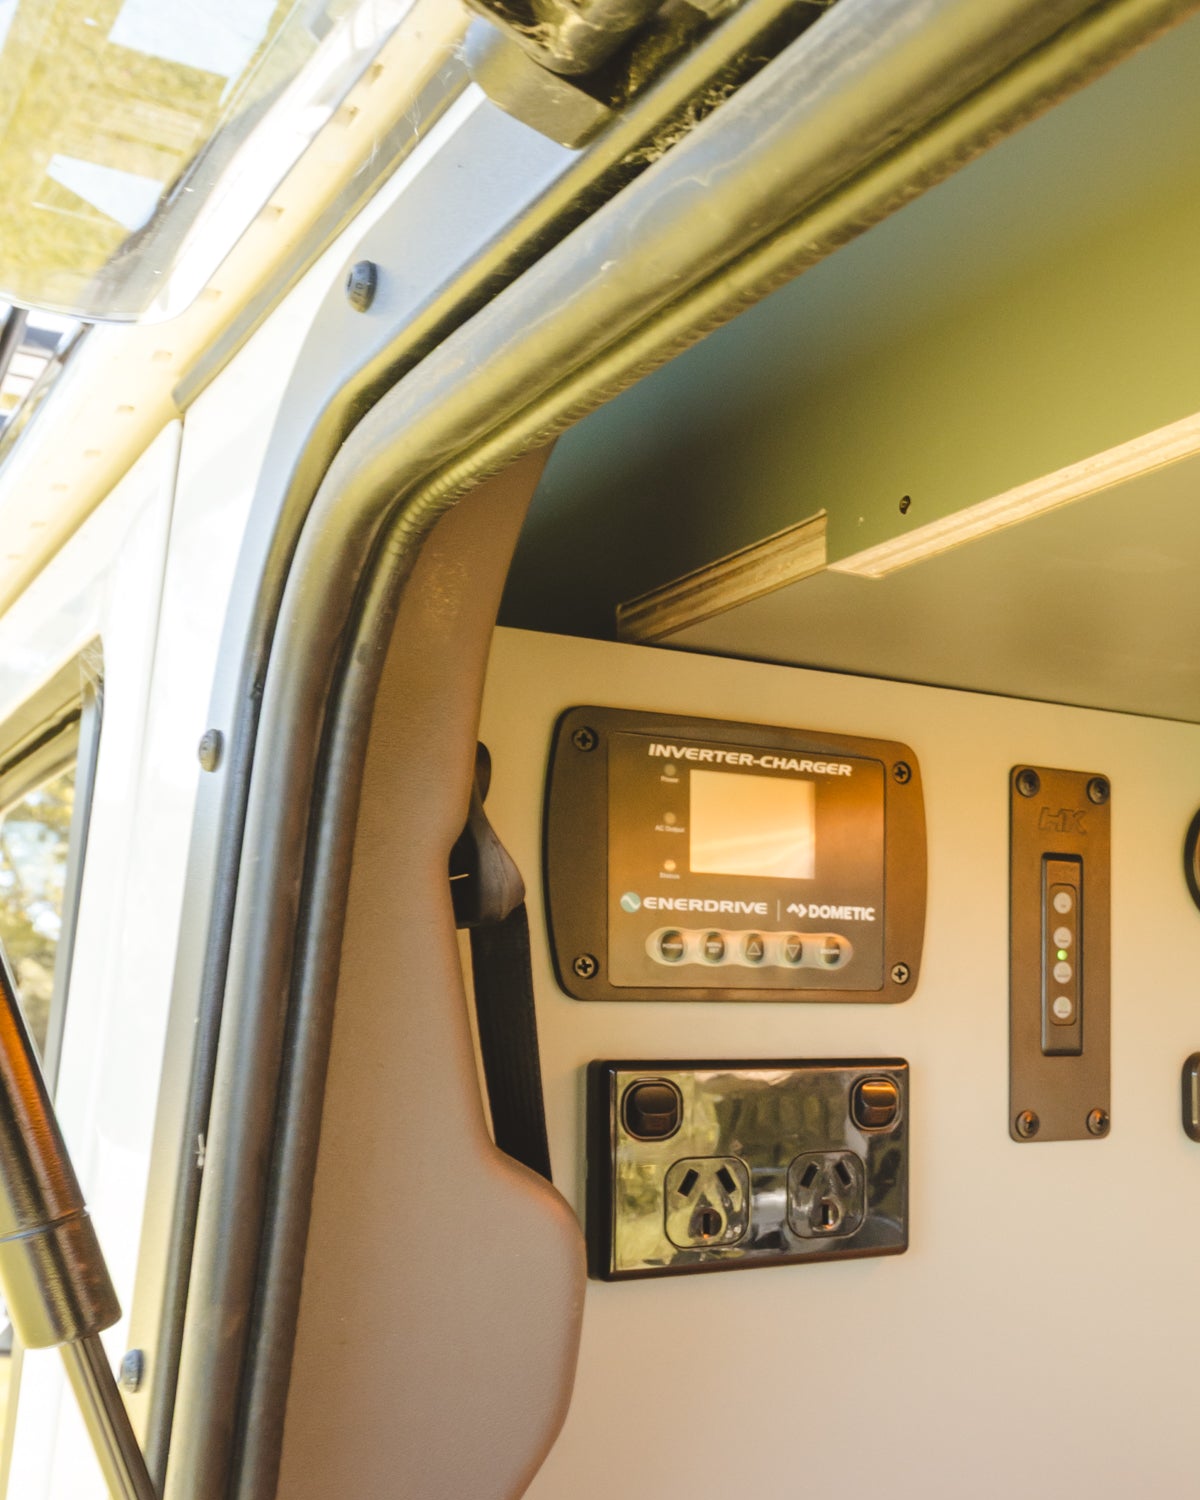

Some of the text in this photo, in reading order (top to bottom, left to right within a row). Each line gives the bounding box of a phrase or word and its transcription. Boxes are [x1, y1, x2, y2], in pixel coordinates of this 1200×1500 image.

[648, 743, 852, 776] INVERTER-CHARGER
[643, 896, 768, 915] ENERDRIVE
[808, 904, 876, 922] DOMETIC
